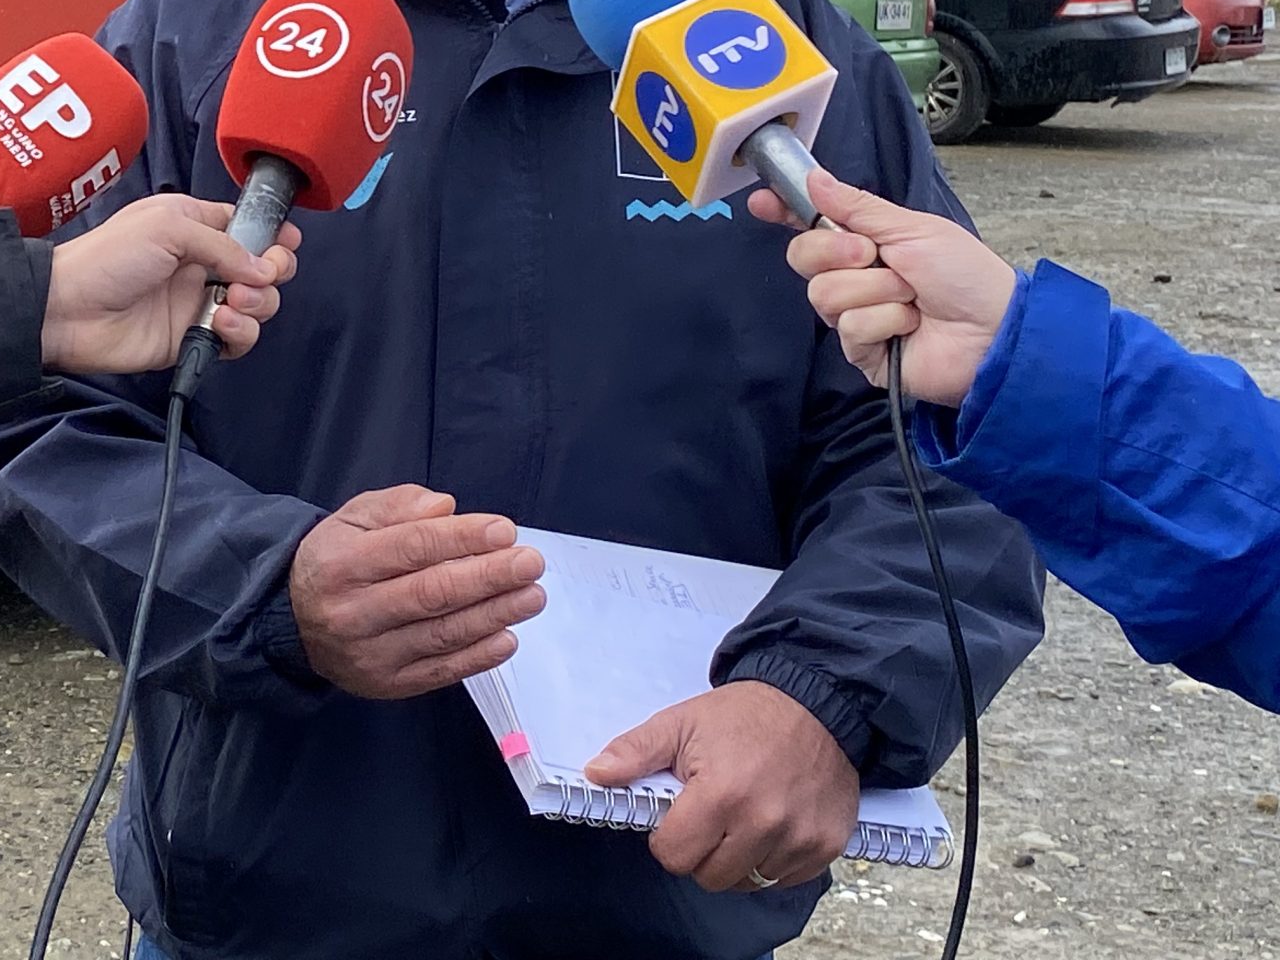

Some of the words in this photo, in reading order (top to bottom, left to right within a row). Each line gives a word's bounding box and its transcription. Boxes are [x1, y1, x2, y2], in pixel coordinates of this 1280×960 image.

[269, 21, 328, 58] 24
[697, 25, 770, 74] ITV
[371, 71, 400, 124] 24
[397, 109, 417, 123] ez
[651, 84, 680, 149] ITV
